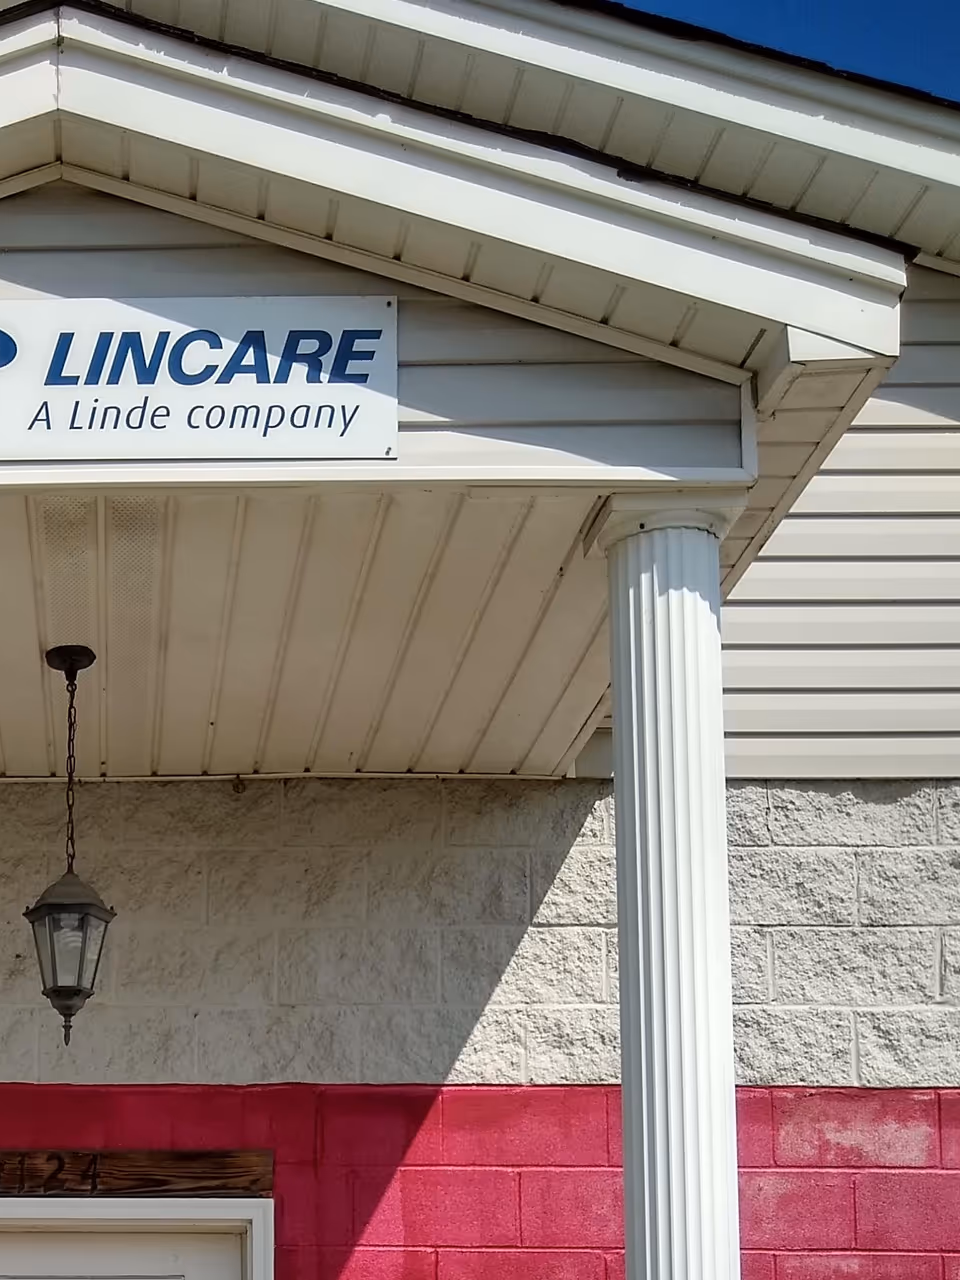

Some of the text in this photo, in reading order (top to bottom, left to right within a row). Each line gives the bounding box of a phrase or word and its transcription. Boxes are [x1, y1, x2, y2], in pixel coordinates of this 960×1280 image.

[43, 328, 383, 386] LINCARE
[28, 397, 360, 436] A Linde company
